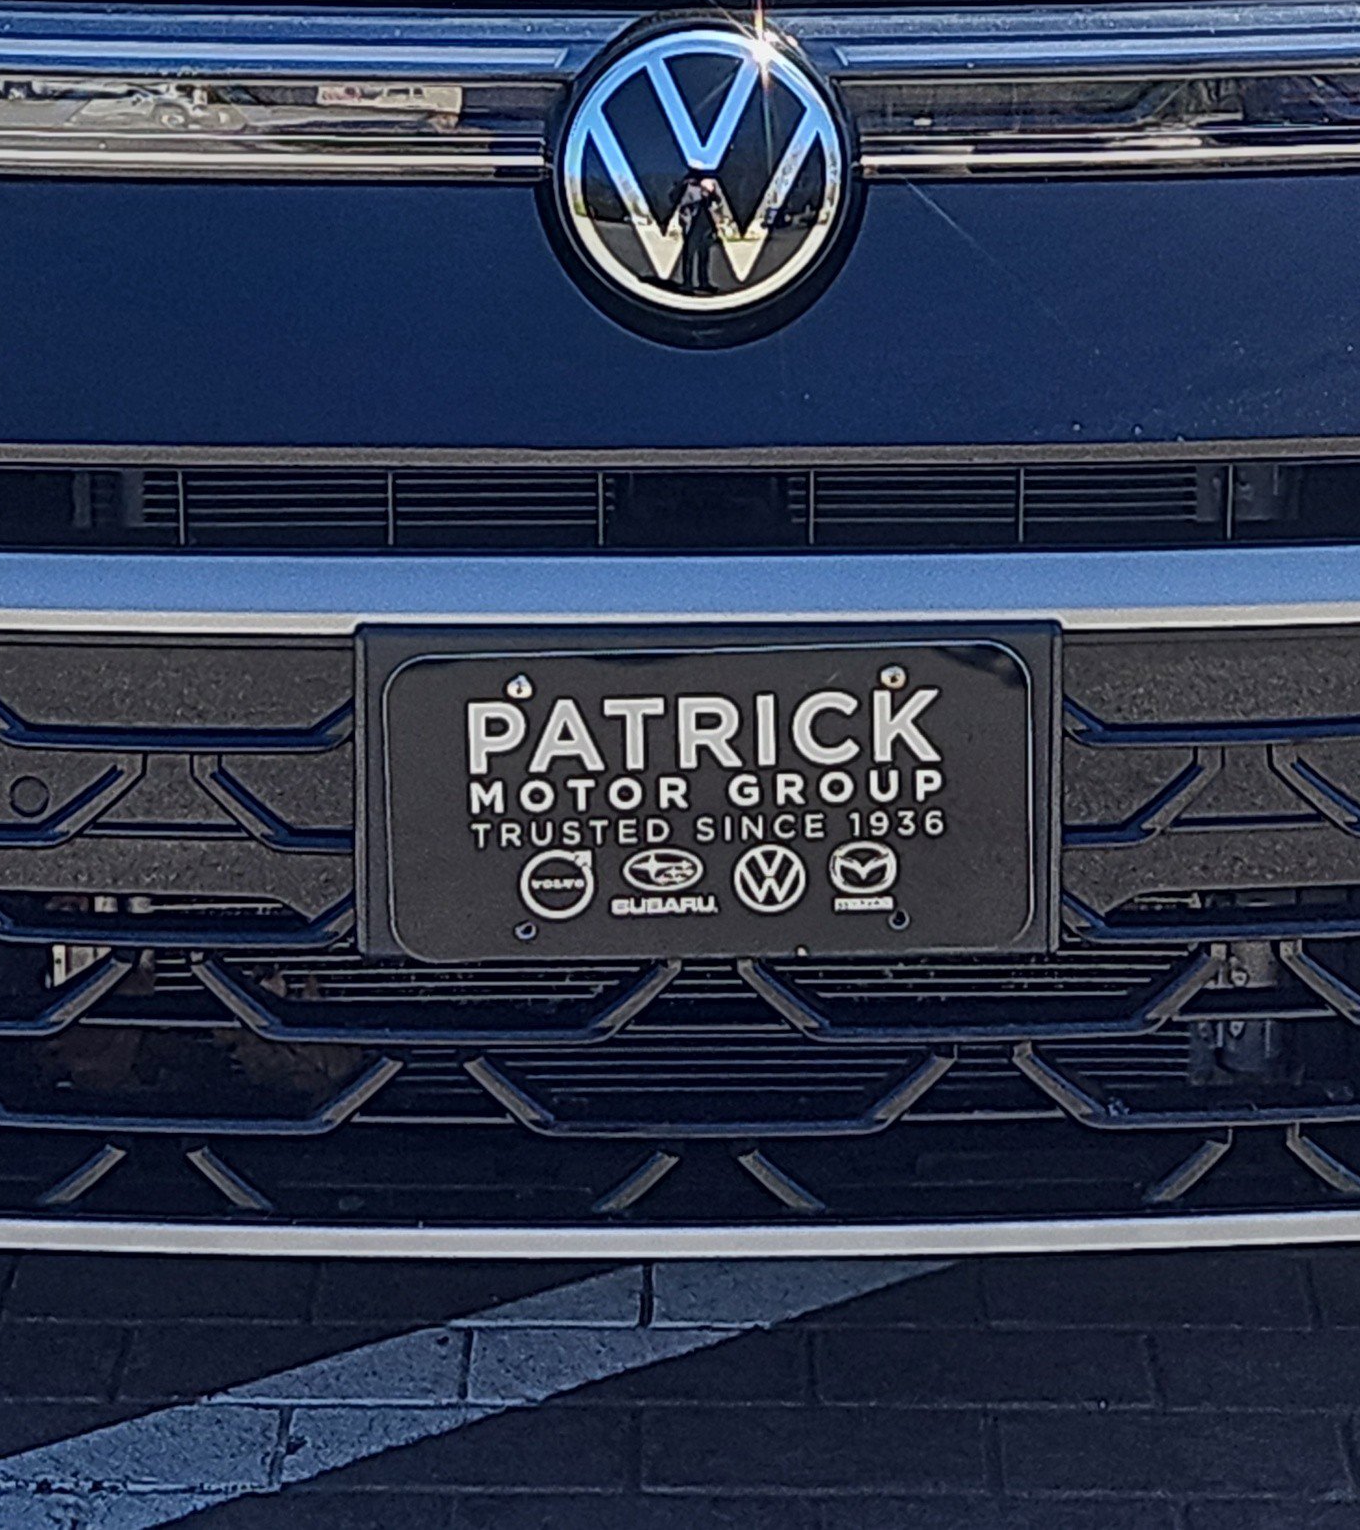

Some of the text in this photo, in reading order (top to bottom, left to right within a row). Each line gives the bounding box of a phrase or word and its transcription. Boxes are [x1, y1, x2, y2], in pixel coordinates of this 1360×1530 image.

[467, 689, 942, 774] PATRICK
[469, 768, 943, 815] MOTOR GROUP
[471, 810, 945, 849] TRUSTED SINCE 1936
